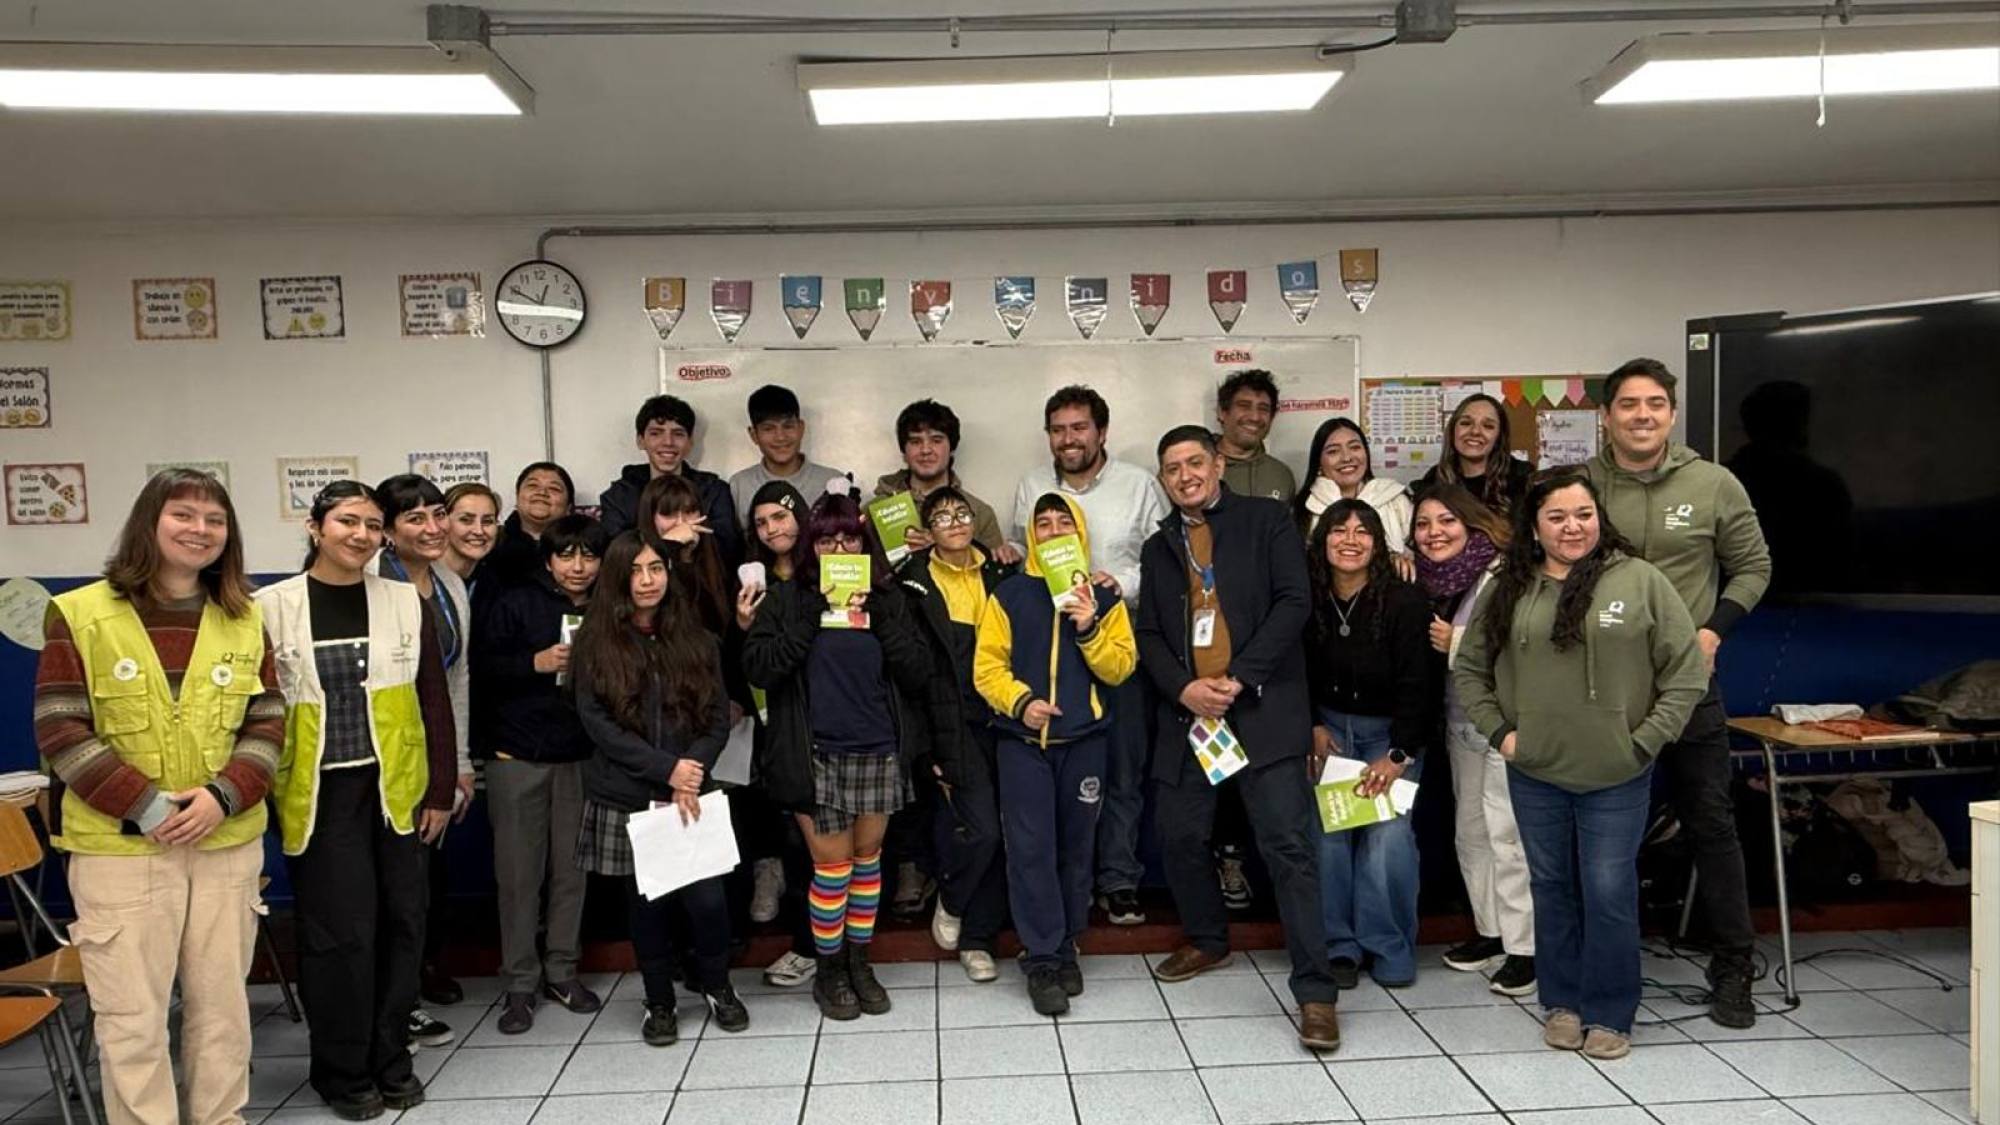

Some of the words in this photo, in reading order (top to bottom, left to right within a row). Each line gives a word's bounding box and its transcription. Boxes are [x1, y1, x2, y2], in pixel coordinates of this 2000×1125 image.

[520, 274, 530, 284] 11
[534, 271, 546, 280] 12
[563, 284, 571, 294] 2
[512, 315, 520, 325] 8
[524, 326, 532, 335] 7
[540, 329, 548, 339] 6
[556, 325, 563, 335] 5
[13, 395, 39, 407] Salón
